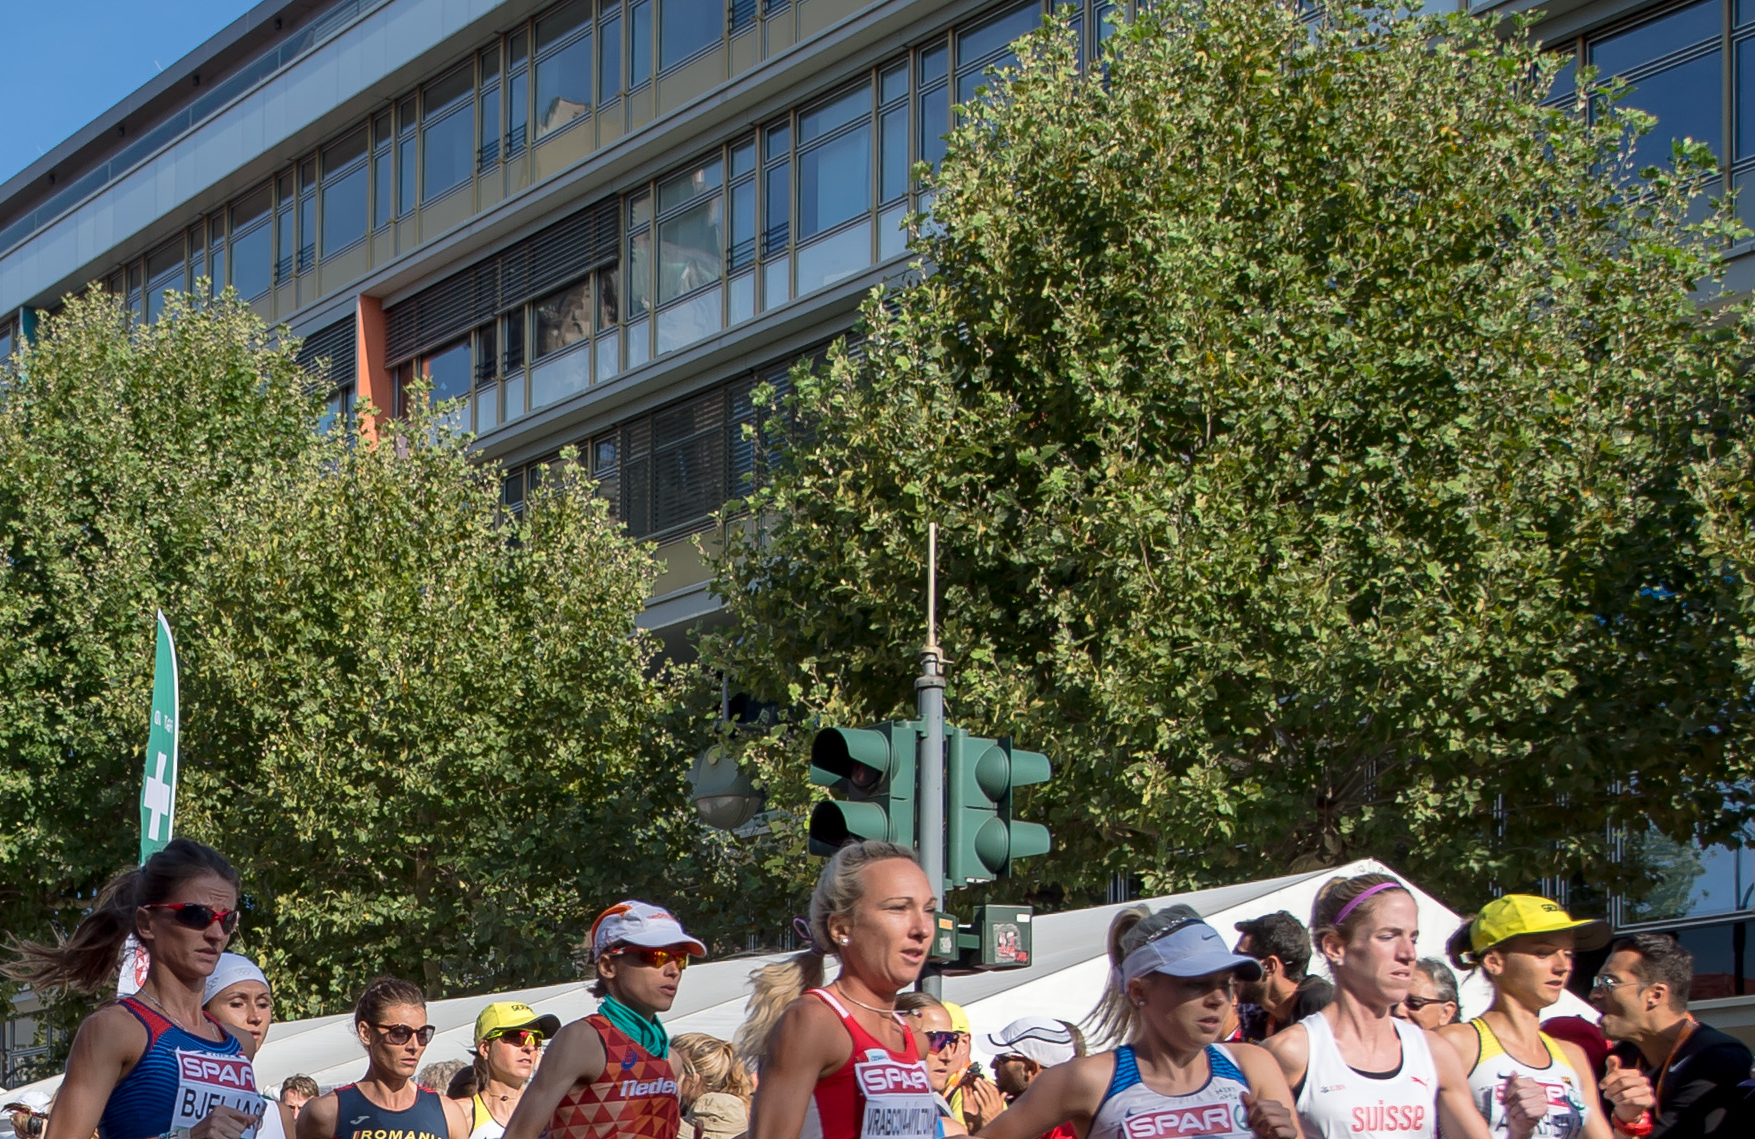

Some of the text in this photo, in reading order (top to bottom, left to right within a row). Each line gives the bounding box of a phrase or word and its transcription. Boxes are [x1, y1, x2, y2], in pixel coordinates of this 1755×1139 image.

[183, 1057, 254, 1088] SPAR
[864, 1068, 928, 1091] SPAR
[1129, 1108, 1229, 1138] SPAR
